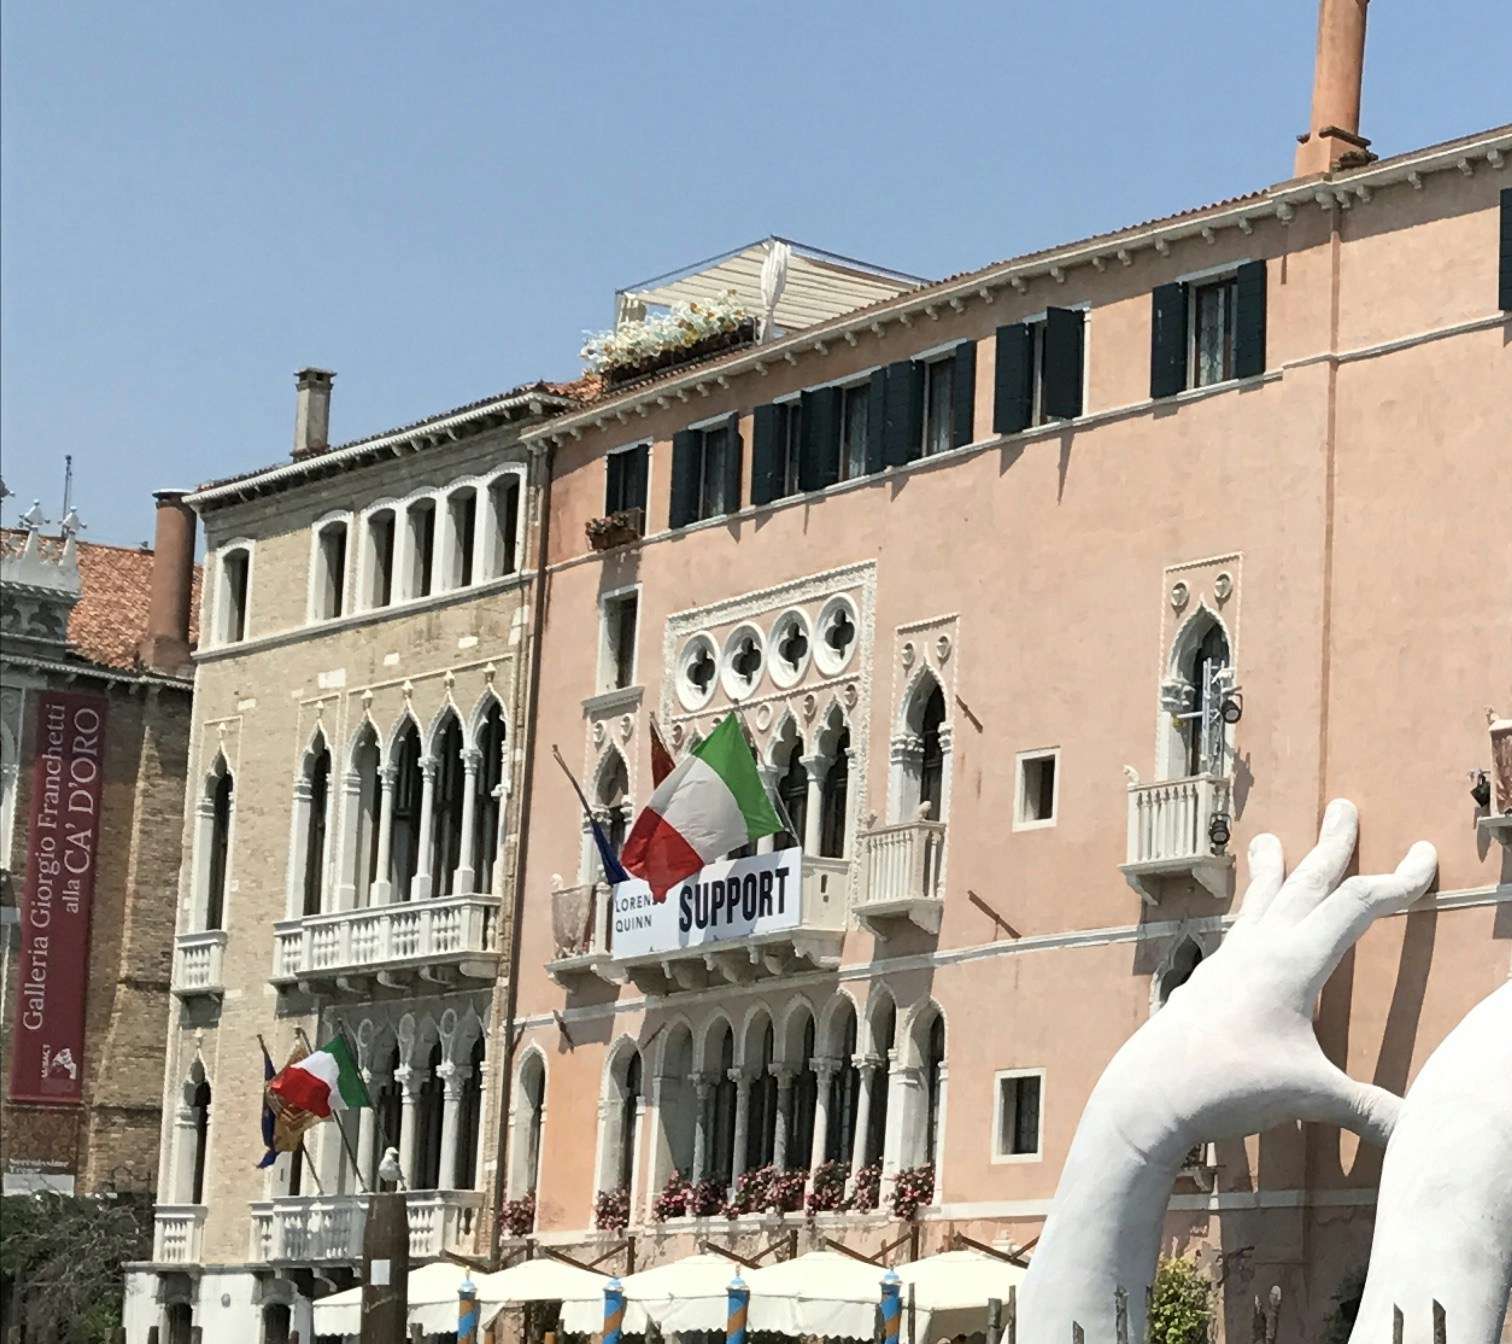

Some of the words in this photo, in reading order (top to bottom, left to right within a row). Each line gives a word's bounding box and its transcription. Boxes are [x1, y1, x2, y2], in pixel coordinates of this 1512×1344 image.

[37, 704, 65, 829] Franchetti
[68, 707, 100, 815] D'ORO
[30, 836, 60, 928] Giorgio
[62, 878, 81, 915] alla
[614, 894, 657, 913] LOREN
[678, 866, 790, 933] SUPPORT
[615, 915, 652, 933] QUINN
[22, 936, 49, 1030] Galleria
